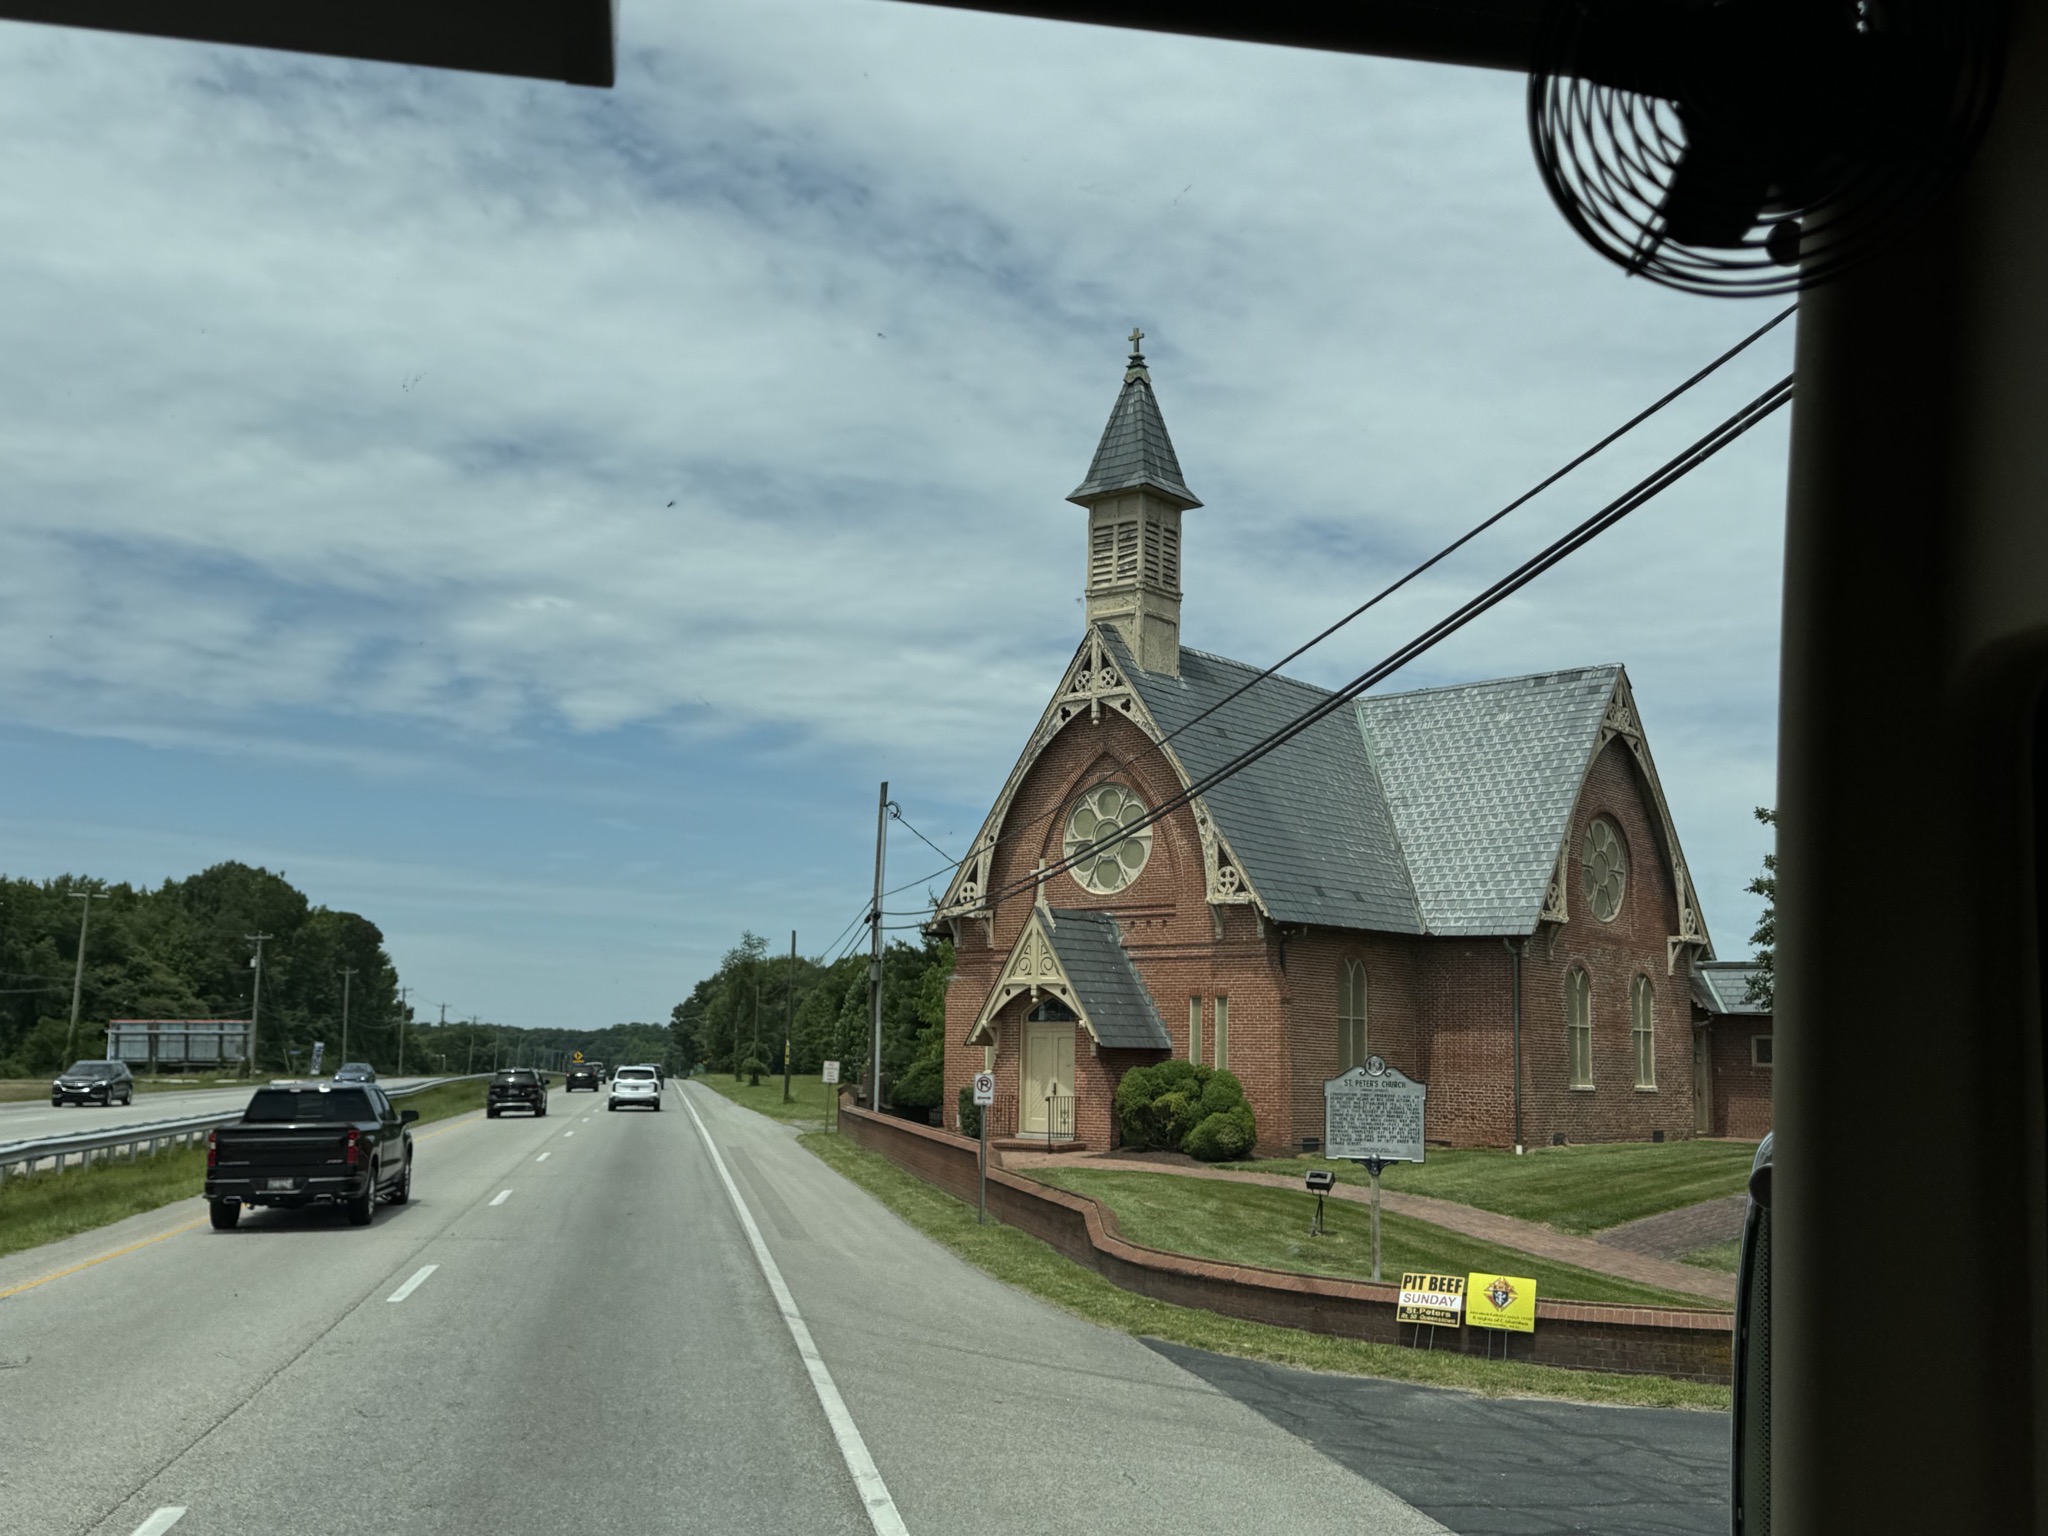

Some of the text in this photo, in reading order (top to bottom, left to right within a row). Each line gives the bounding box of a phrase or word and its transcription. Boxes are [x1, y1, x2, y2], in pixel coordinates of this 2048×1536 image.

[1355, 1080, 1379, 1088] PETER'S
[1381, 1080, 1406, 1088] CHURCH
[1402, 1275, 1463, 1294] PIT BEEF
[1403, 1293, 1457, 1307] SUNDAY
